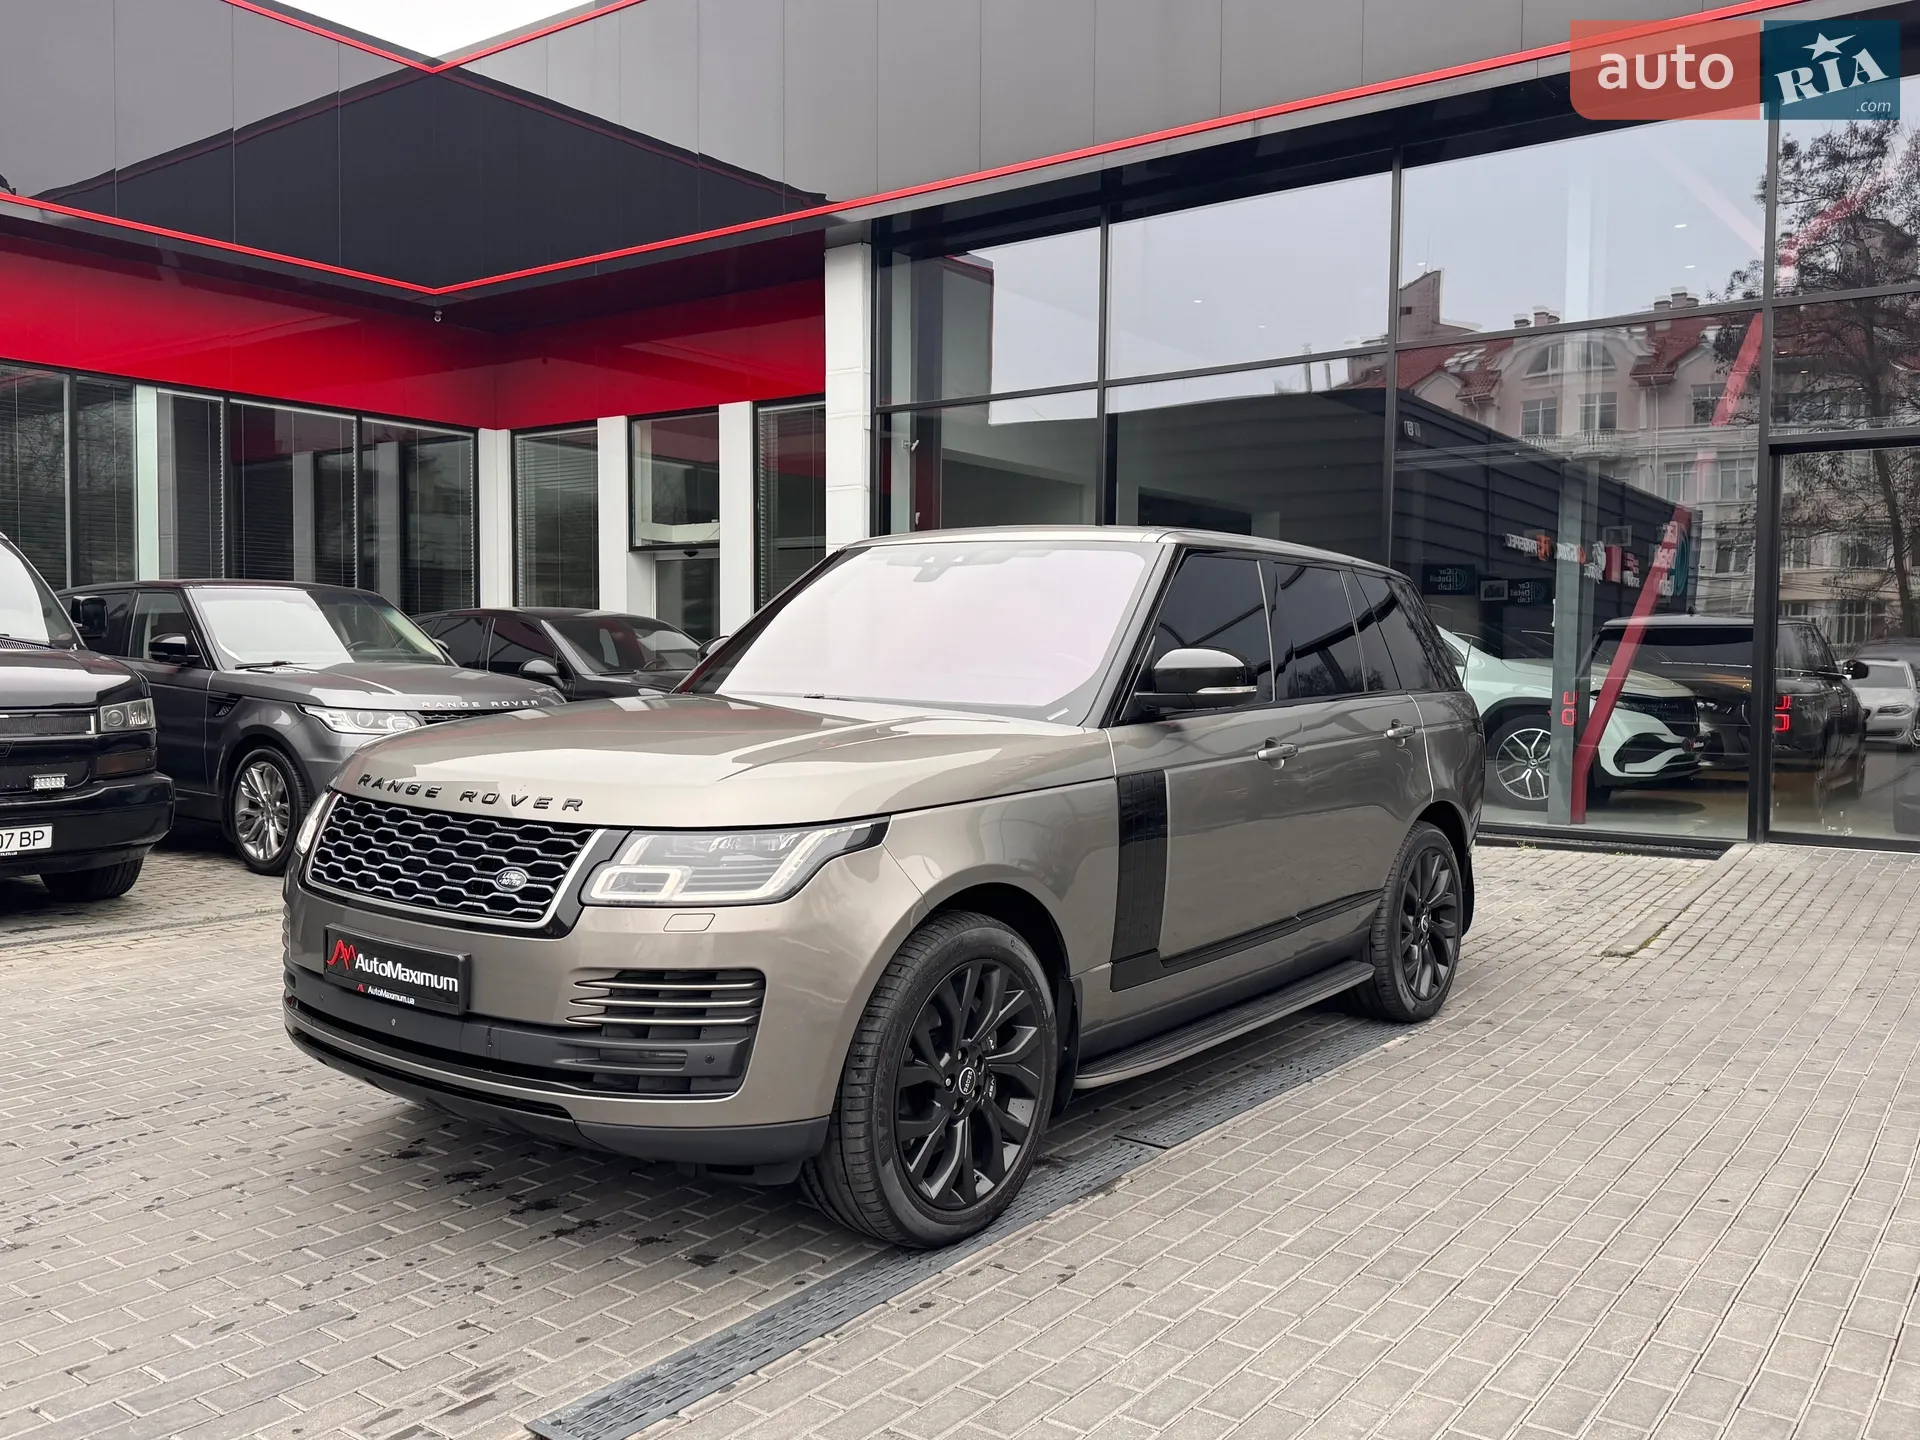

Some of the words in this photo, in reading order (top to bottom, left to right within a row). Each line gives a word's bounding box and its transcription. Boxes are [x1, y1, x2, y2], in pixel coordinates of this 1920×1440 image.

[357, 773, 442, 799] RANGE
[459, 790, 583, 811] ROVER
[20, 830, 45, 848] BP
[355, 953, 459, 993] AutoMaximum
[367, 985, 416, 1006] AutoMaximum.ua
